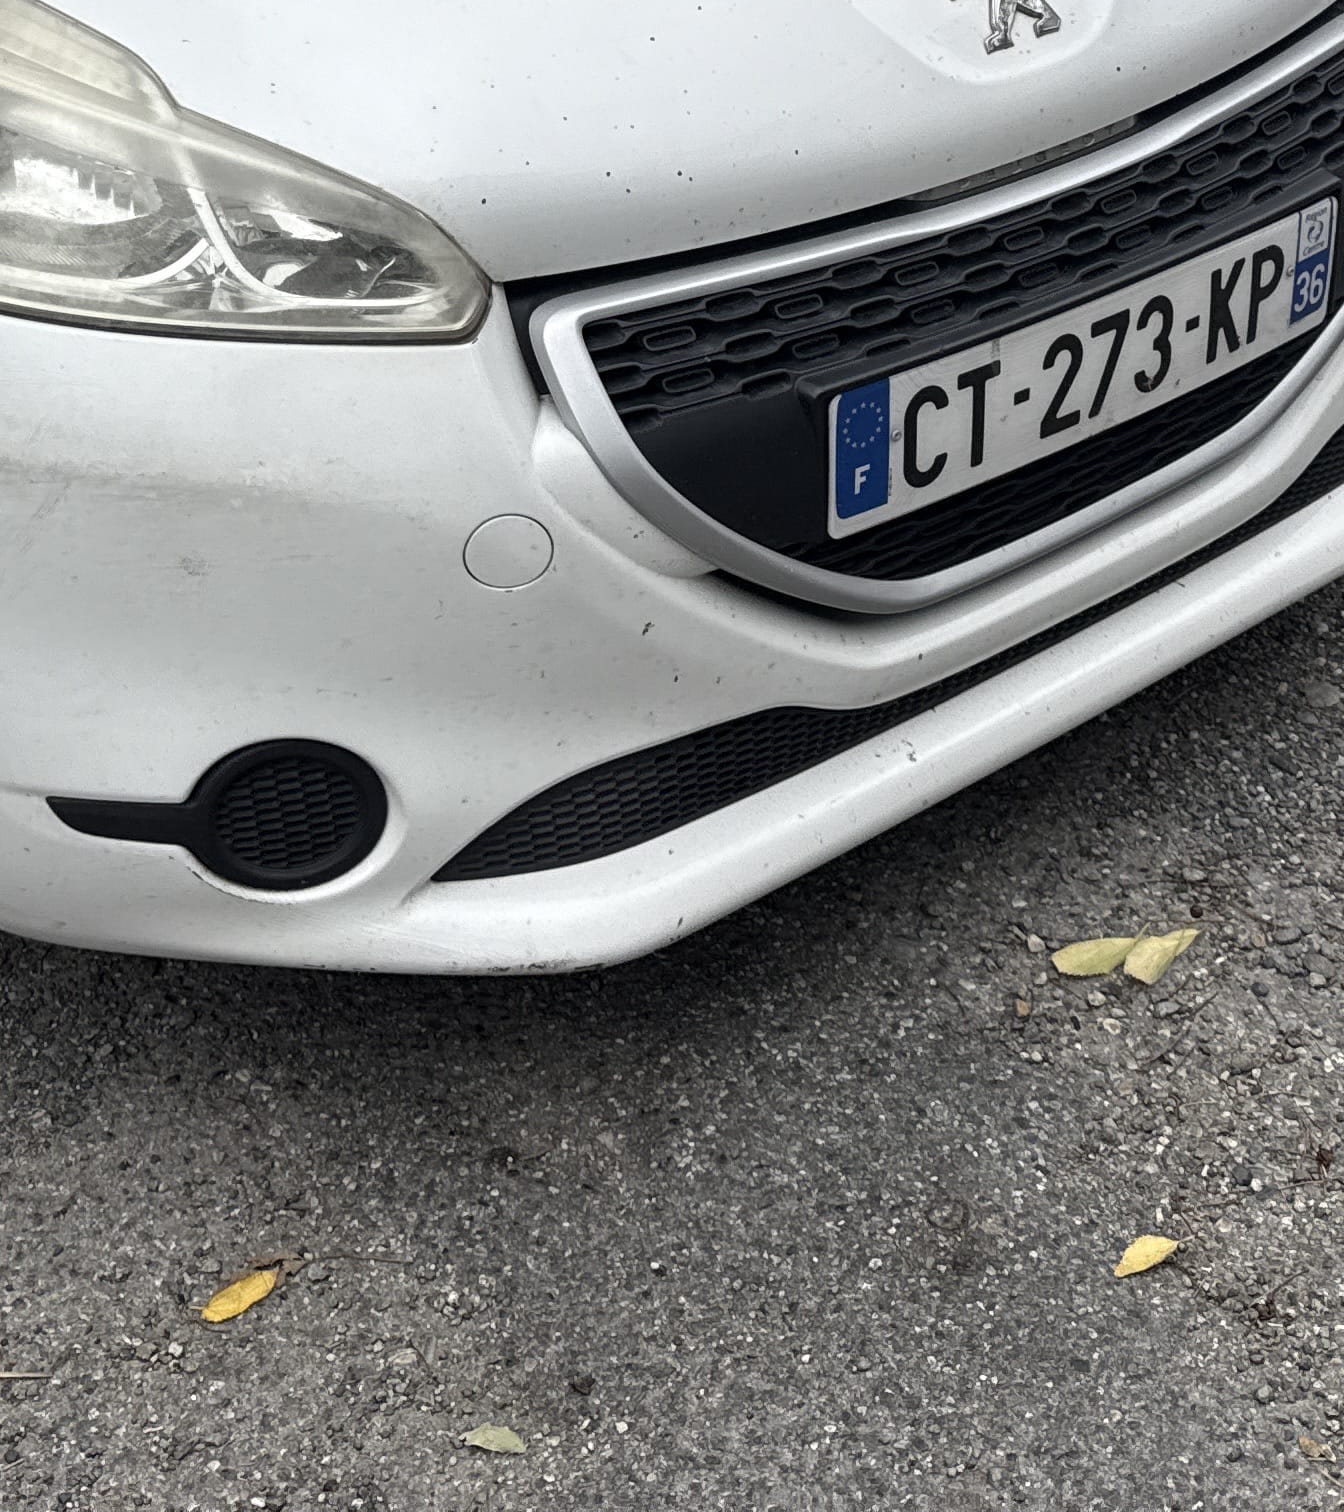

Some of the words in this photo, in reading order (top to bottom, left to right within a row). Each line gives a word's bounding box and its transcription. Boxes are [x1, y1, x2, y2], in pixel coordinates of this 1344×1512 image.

[1294, 263, 1325, 312] 36
[854, 464, 871, 495] F
[902, 243, 1284, 488] CT-273-KP
